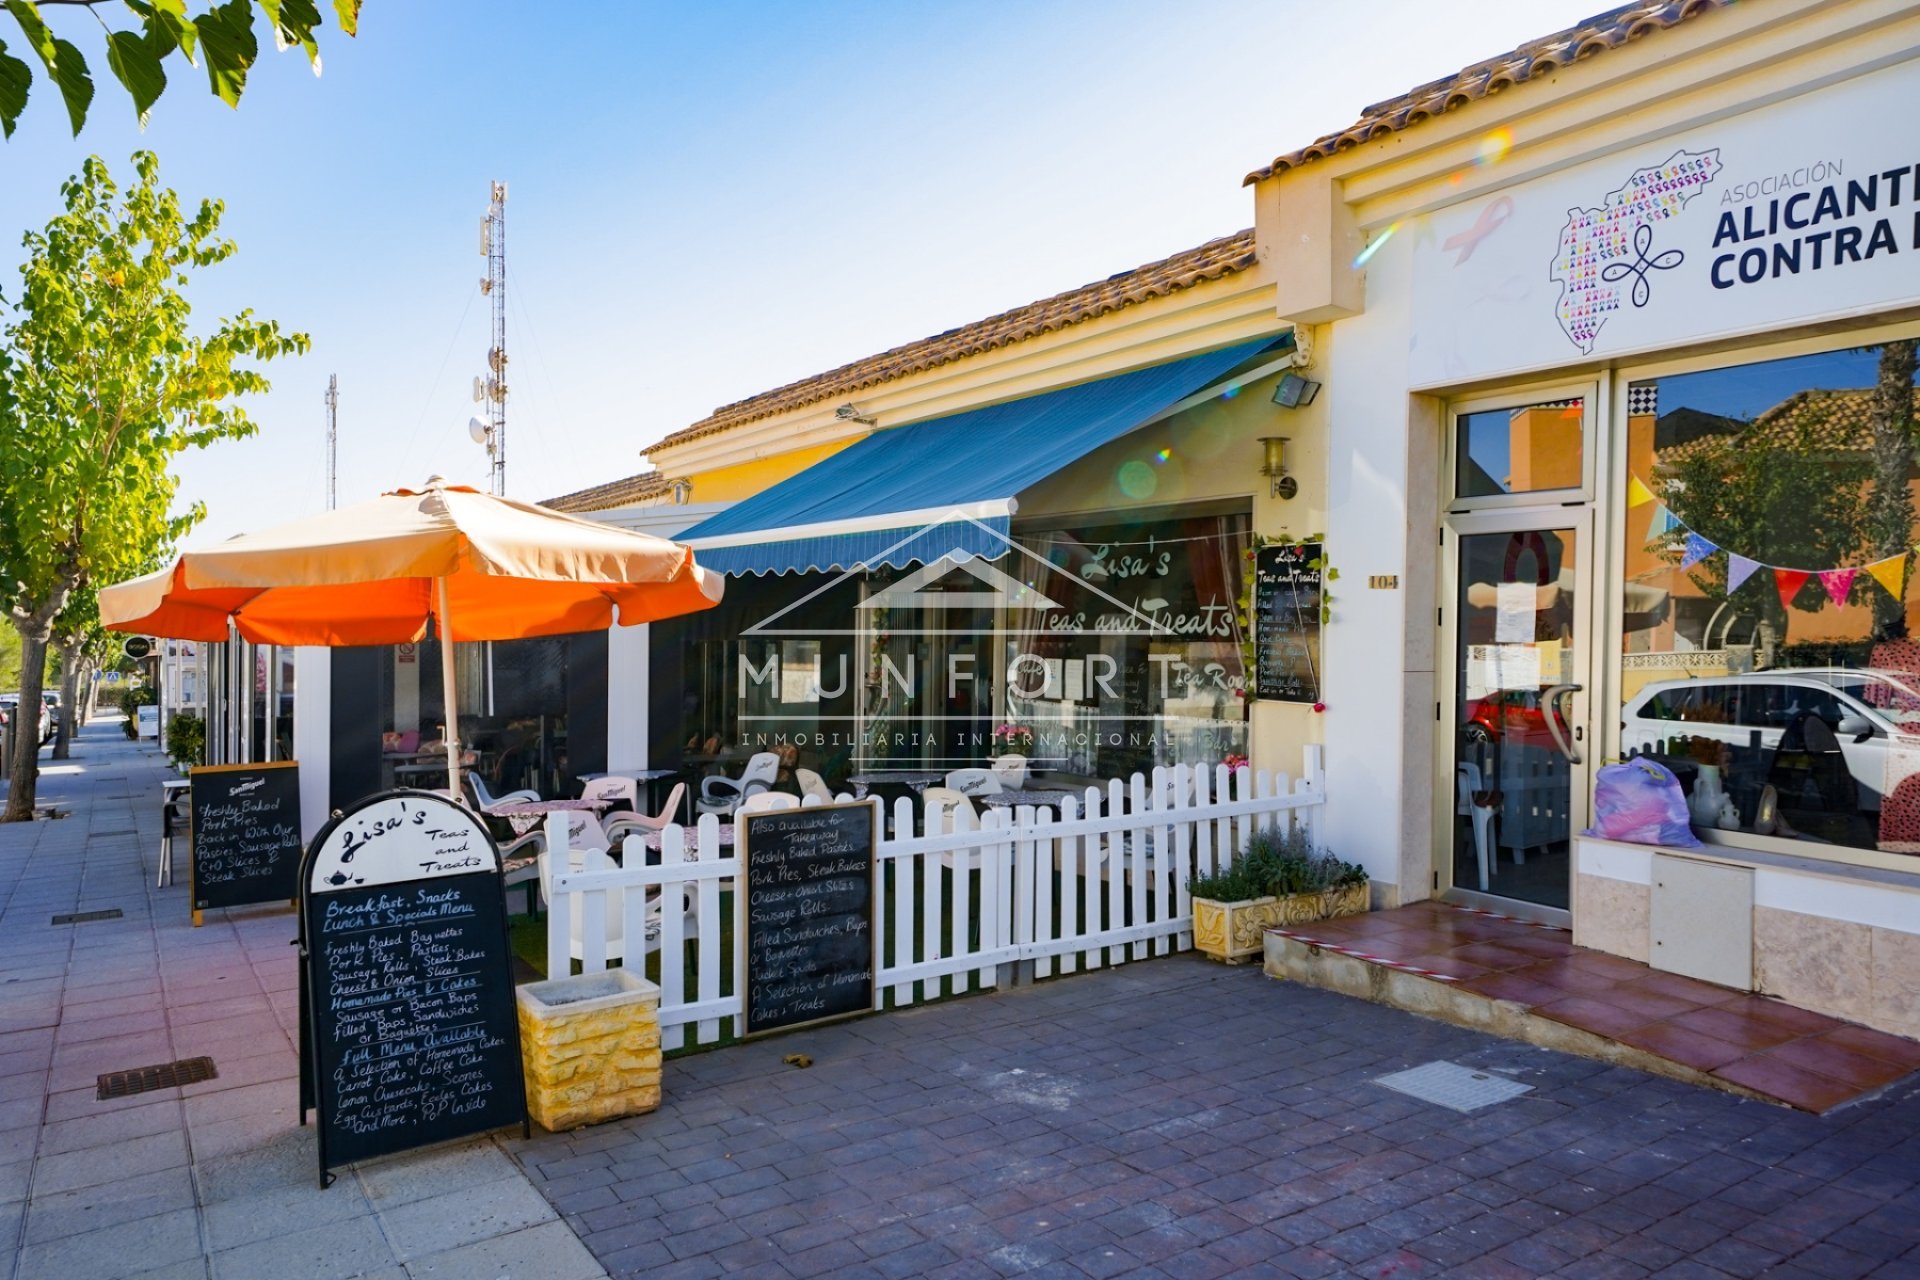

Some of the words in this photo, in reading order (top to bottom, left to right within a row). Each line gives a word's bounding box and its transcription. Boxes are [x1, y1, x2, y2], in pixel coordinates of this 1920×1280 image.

[1719, 158, 1844, 207] ASOCIACIÓN
[1711, 218, 1899, 290] CONTRA
[1080, 535, 1171, 579] Lisa's
[1034, 599, 1086, 634] Teas
[1094, 595, 1141, 632] and
[1141, 593, 1233, 637] Treats
[1170, 662, 1204, 685] Tea
[340, 801, 426, 863] Lisa's
[424, 828, 470, 842] Teas
[751, 819, 775, 835] Also
[783, 829, 840, 844] Takeaway
[434, 841, 471, 856] and
[751, 849, 786, 869] Freshly
[789, 846, 817, 859] Baked
[418, 856, 482, 874] Treats
[750, 868, 775, 887] Pork
[807, 862, 835, 878] Steak
[838, 859, 867, 872] Bakes
[416, 887, 462, 904] Snacks
[751, 890, 786, 906] Cheese
[322, 915, 365, 933] Lunch
[369, 912, 380, 926] &
[386, 905, 438, 925] Specials
[439, 901, 476, 916] Menu
[751, 908, 797, 926] Sausage
[368, 934, 404, 949] Baked
[327, 956, 365, 971] Pork
[331, 968, 378, 983] Sausage
[422, 952, 454, 967] Steak
[455, 949, 486, 963] Bakes
[330, 981, 368, 996] Cheese
[383, 973, 416, 988] Onion
[425, 965, 459, 978] Slices
[440, 977, 478, 992] Cakes
[765, 981, 813, 999] Selection
[336, 1009, 385, 1026] Sausage
[391, 1005, 403, 1014] or
[409, 997, 444, 1011] Bacon
[447, 991, 478, 1008] Baps
[413, 1002, 480, 1022] Sandwiches
[751, 1007, 778, 1023] Cakes
[788, 996, 825, 1014] Treats
[358, 1033, 372, 1045] or
[380, 1041, 416, 1056] Menu
[350, 1059, 401, 1078] Selection
[406, 1053, 420, 1067] of
[479, 1036, 505, 1050] Cakes
[337, 1078, 372, 1094] Carrot
[419, 1060, 454, 1075] Coffee
[333, 1112, 357, 1130] Egg
[460, 1081, 493, 1097] Cakes
